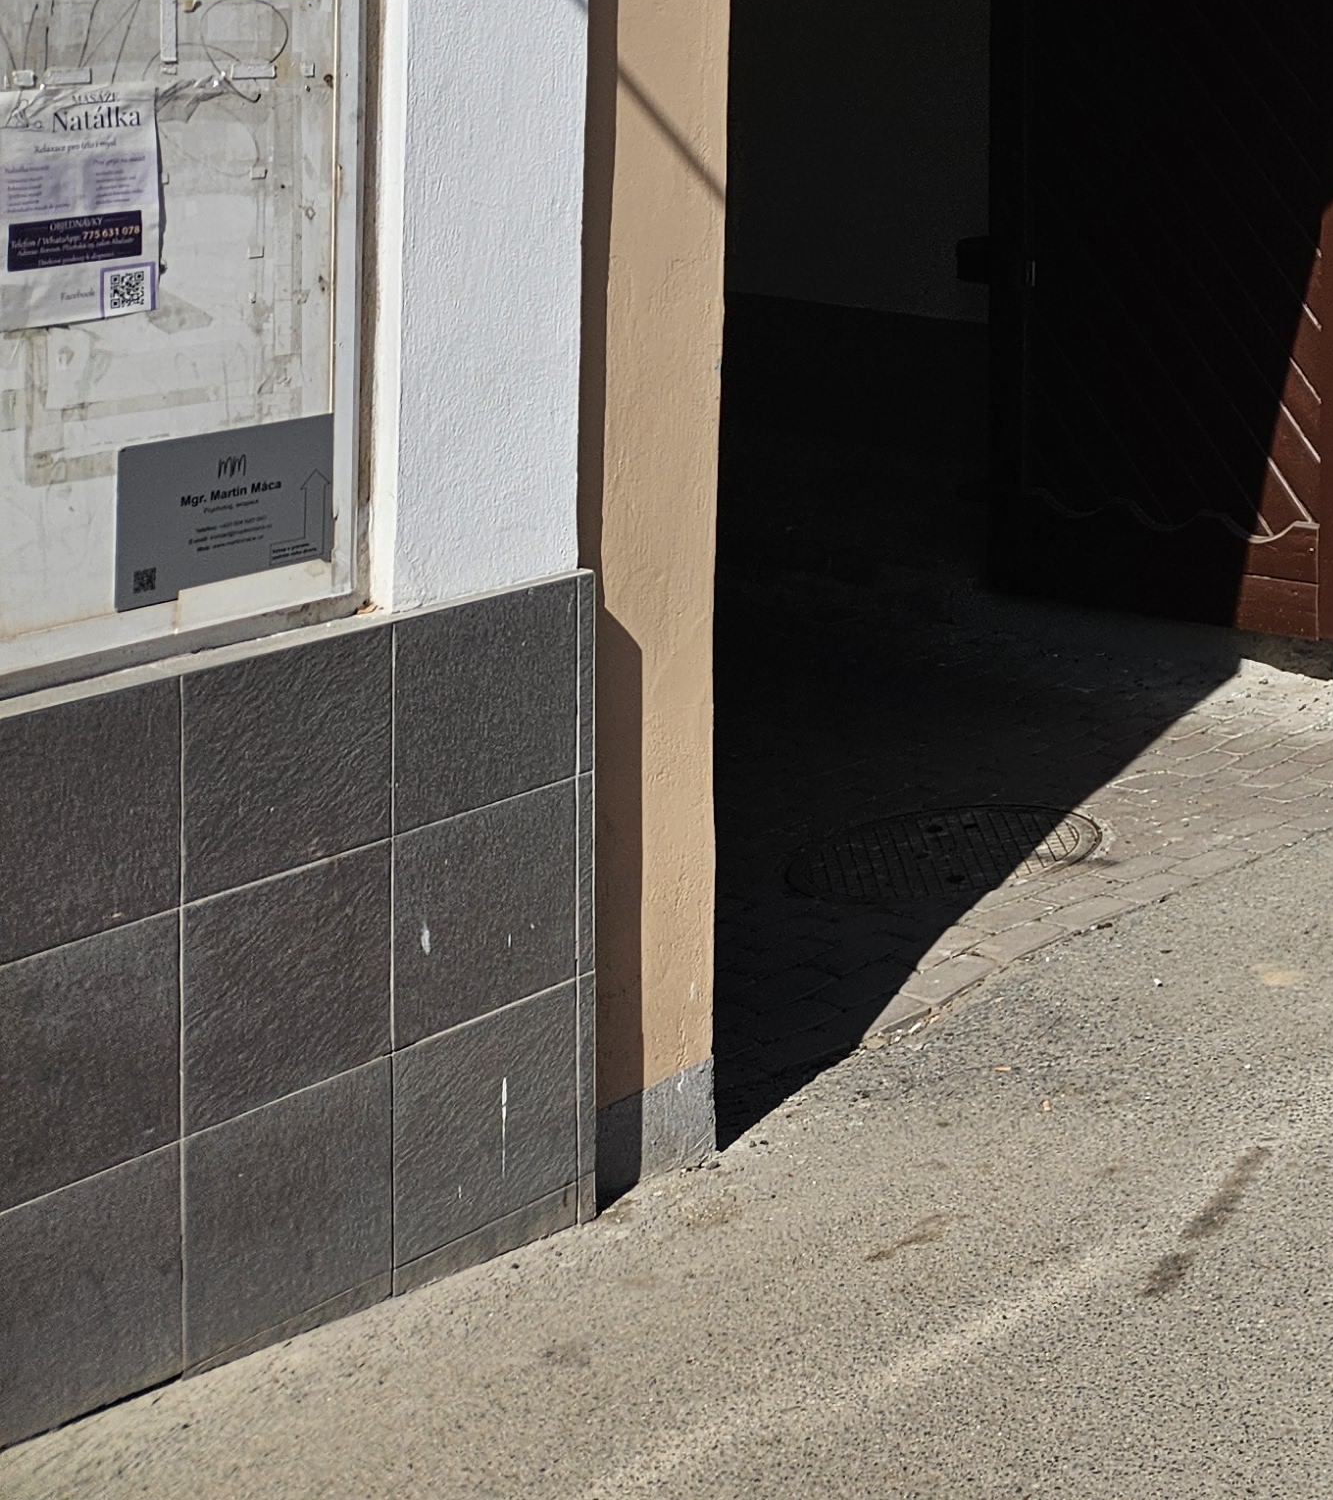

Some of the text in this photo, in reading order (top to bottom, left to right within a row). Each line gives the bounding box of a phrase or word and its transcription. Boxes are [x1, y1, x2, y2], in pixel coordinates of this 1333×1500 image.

[51, 105, 142, 134] Natálka
[82, 229, 101, 241] 775
[102, 227, 120, 238] 631
[121, 225, 141, 235] 078
[180, 478, 282, 508] Mgr. Martin Máca
